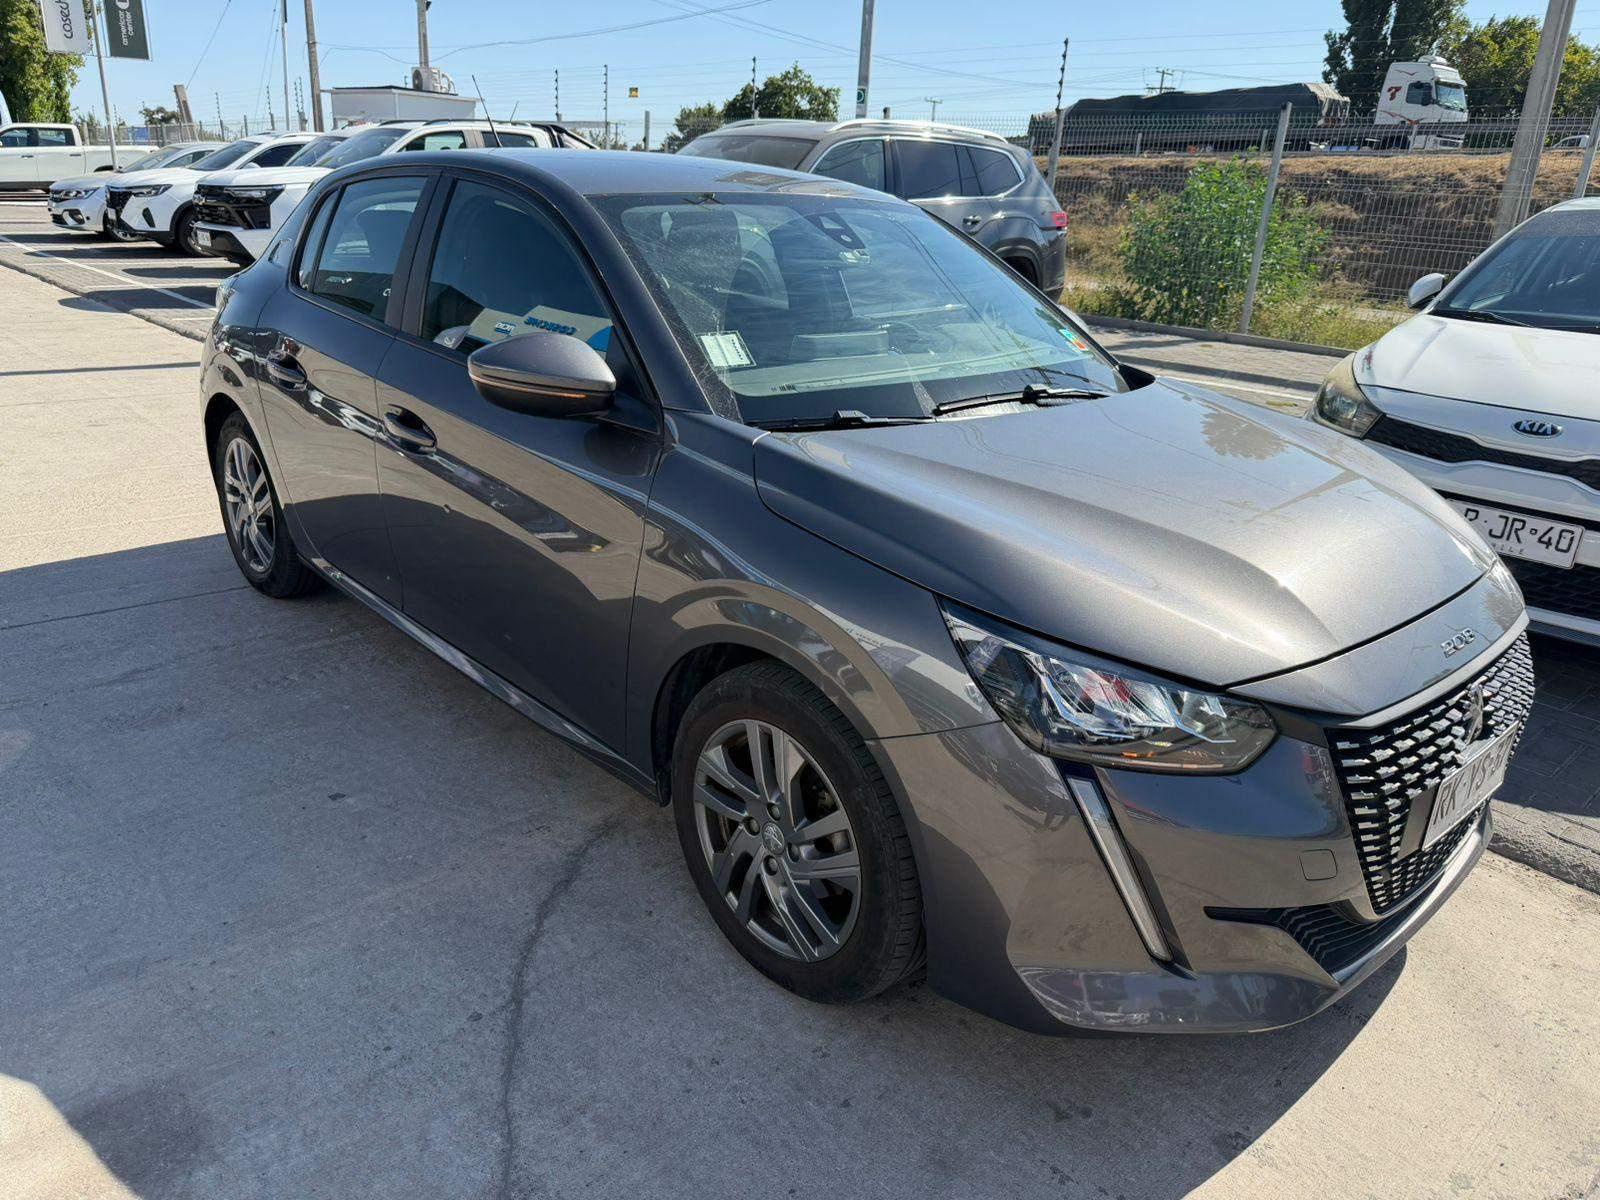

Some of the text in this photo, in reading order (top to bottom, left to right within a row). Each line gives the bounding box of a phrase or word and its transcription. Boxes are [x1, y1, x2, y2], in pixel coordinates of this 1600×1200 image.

[125, 11, 134, 36] center
[1519, 419, 1552, 435] KIA
[1440, 628, 1476, 658] 208
